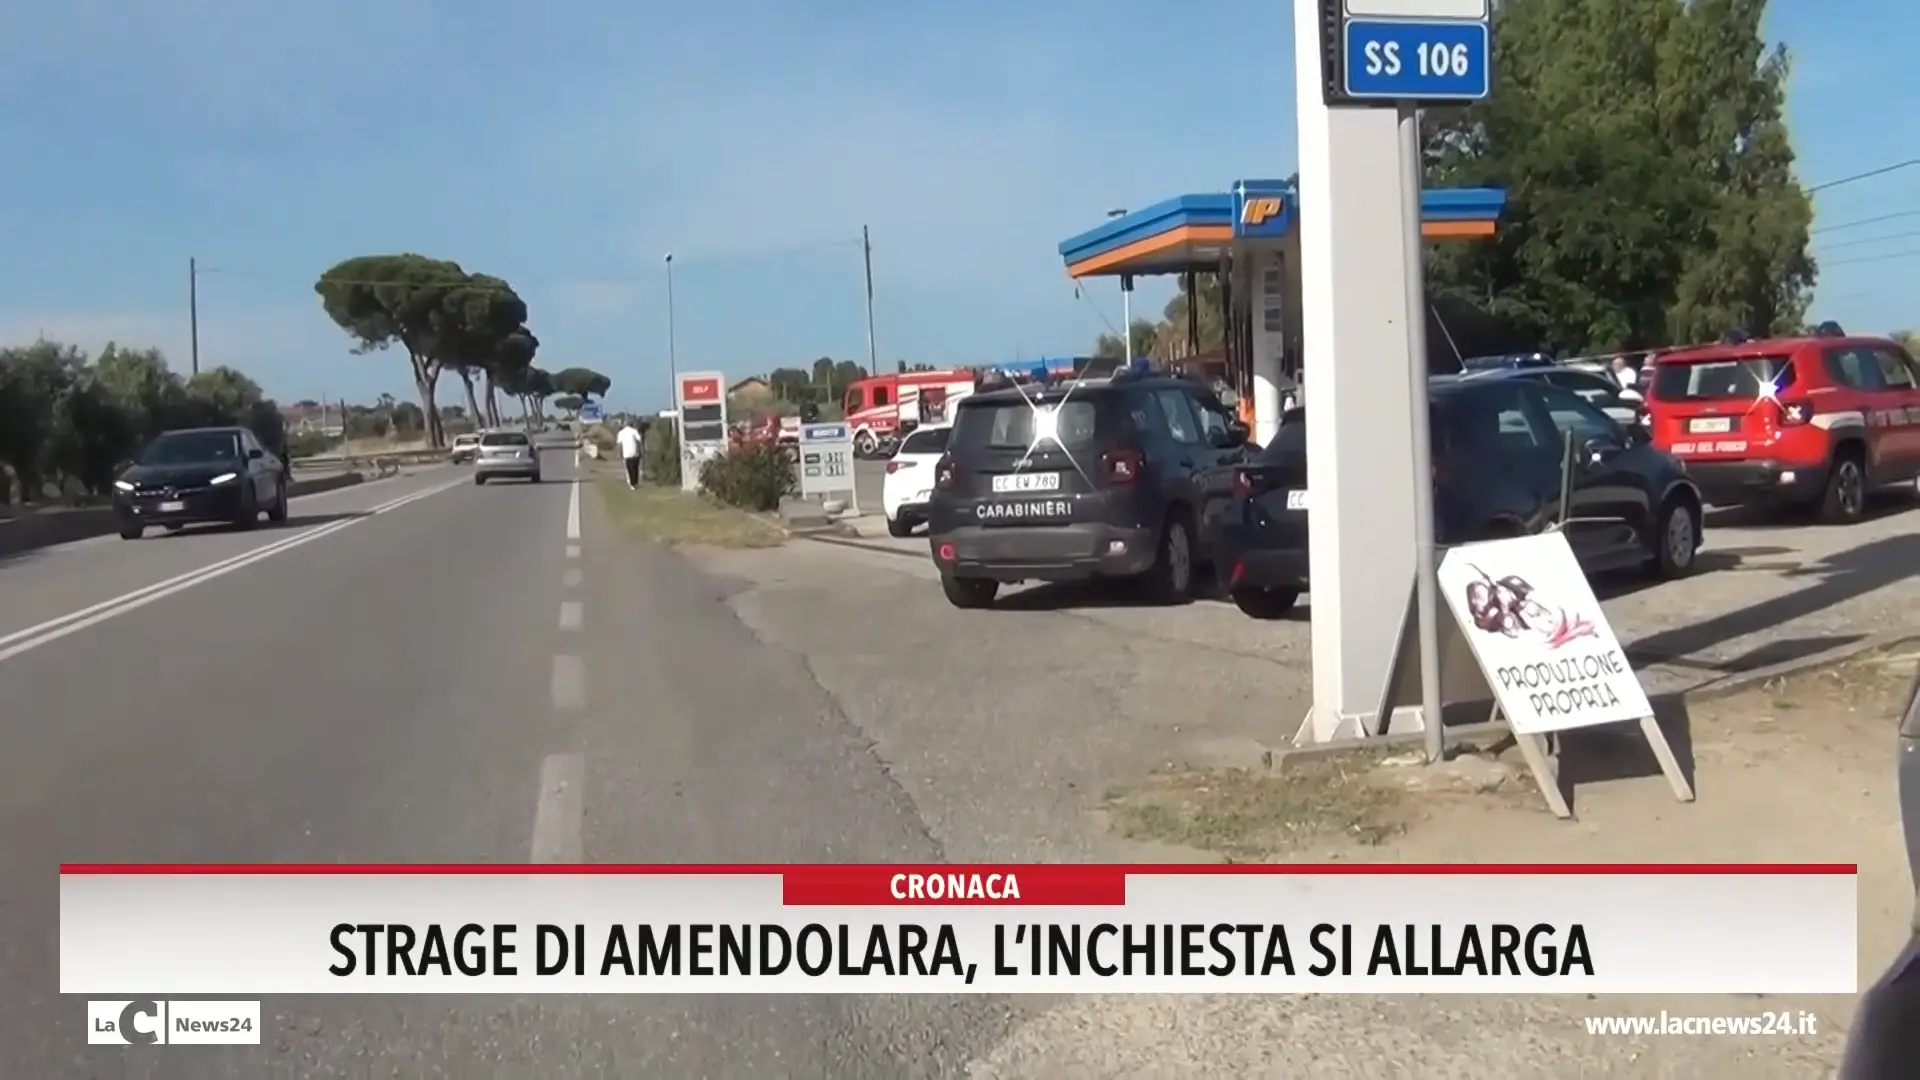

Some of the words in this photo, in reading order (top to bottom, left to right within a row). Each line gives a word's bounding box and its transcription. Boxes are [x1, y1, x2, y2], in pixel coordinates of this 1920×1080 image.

[1364, 40, 1401, 75] SS
[1417, 42, 1468, 76] 106
[1240, 198, 1281, 224] IP
[996, 477, 1009, 490] CC
[1015, 476, 1030, 488] EW
[976, 502, 1072, 518] CARABINIERI
[1497, 650, 1623, 690] PRODUZIONE
[1529, 682, 1620, 717] PROPRIA
